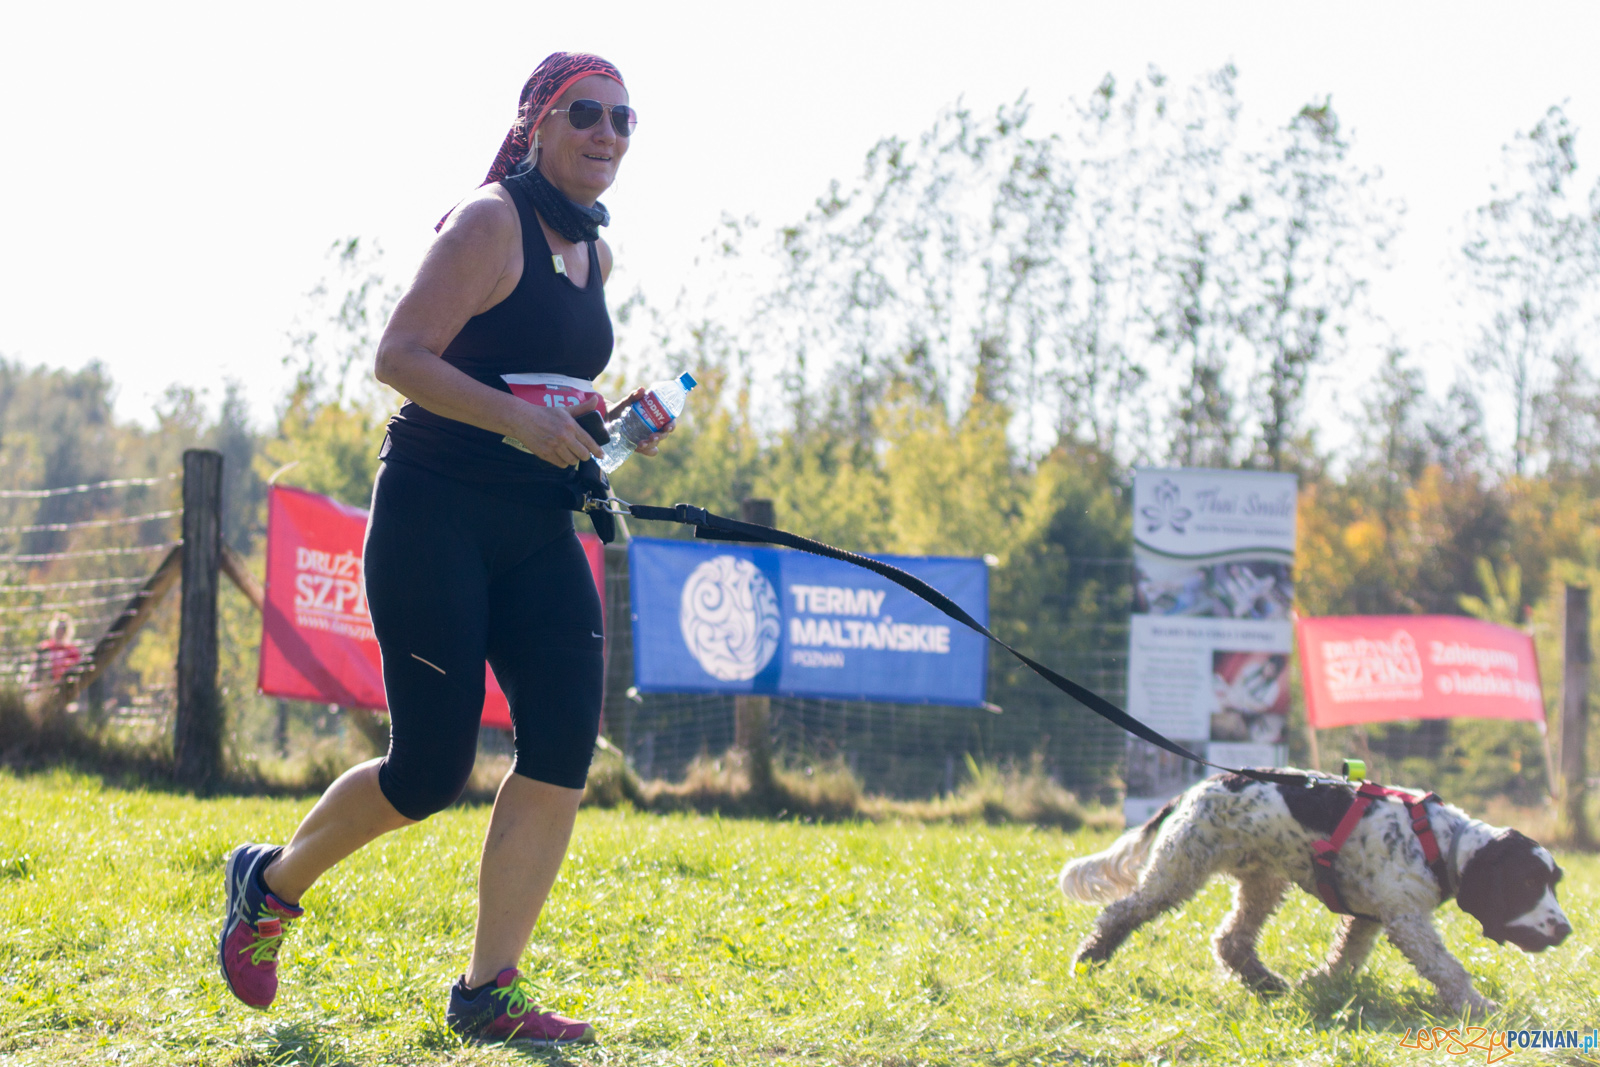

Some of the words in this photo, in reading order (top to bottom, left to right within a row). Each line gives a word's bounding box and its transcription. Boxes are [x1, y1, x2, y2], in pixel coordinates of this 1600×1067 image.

[643, 393, 666, 421] LODNY
[789, 584, 886, 617] TERMY
[789, 615, 951, 654] MALTAŃSKIE
